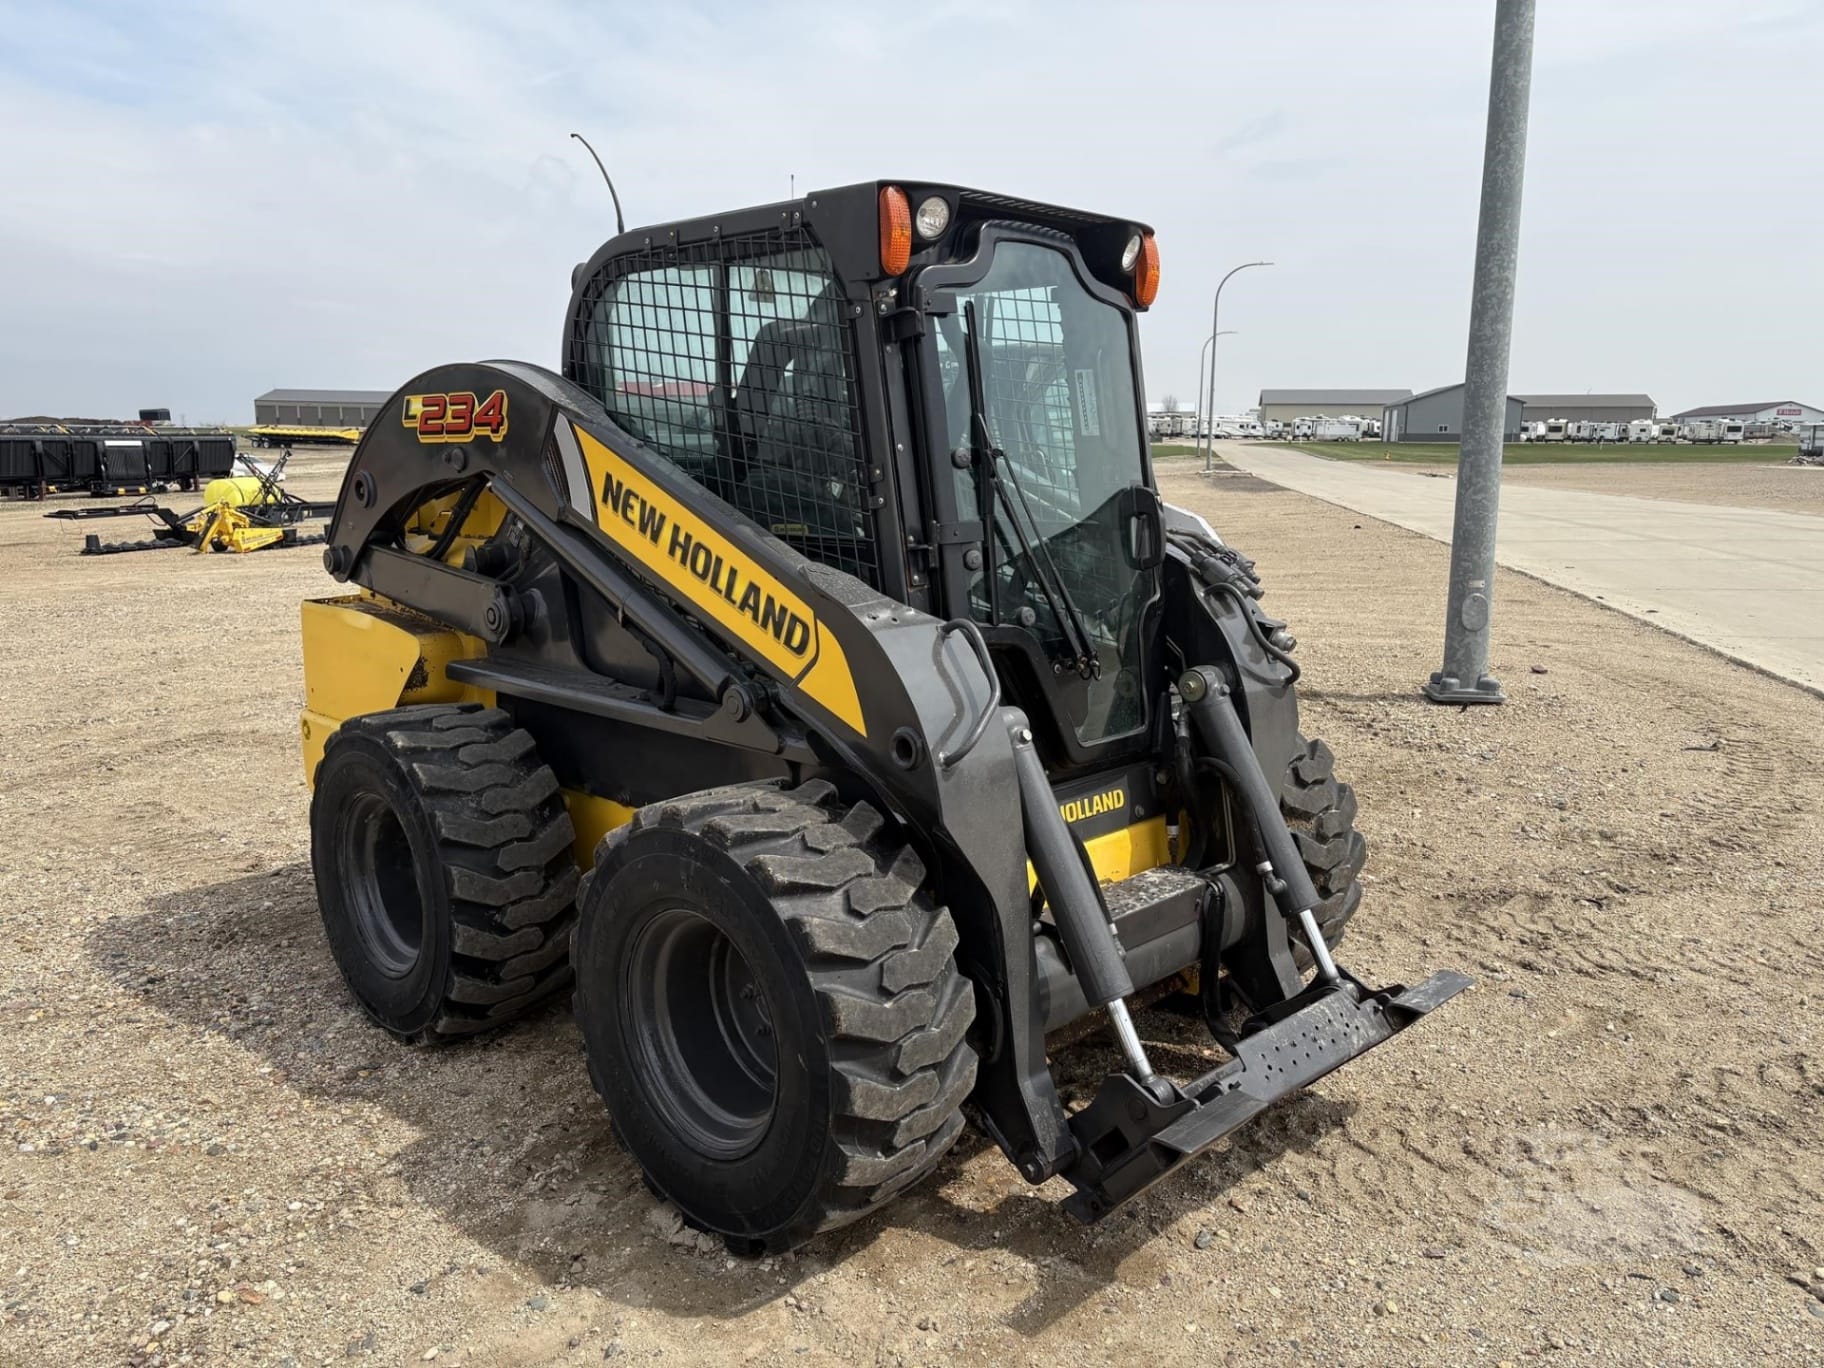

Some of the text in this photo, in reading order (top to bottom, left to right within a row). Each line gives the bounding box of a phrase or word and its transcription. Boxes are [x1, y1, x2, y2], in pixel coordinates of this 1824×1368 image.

[402, 389, 508, 443] L234
[602, 471, 811, 657] NEW HOLLAND
